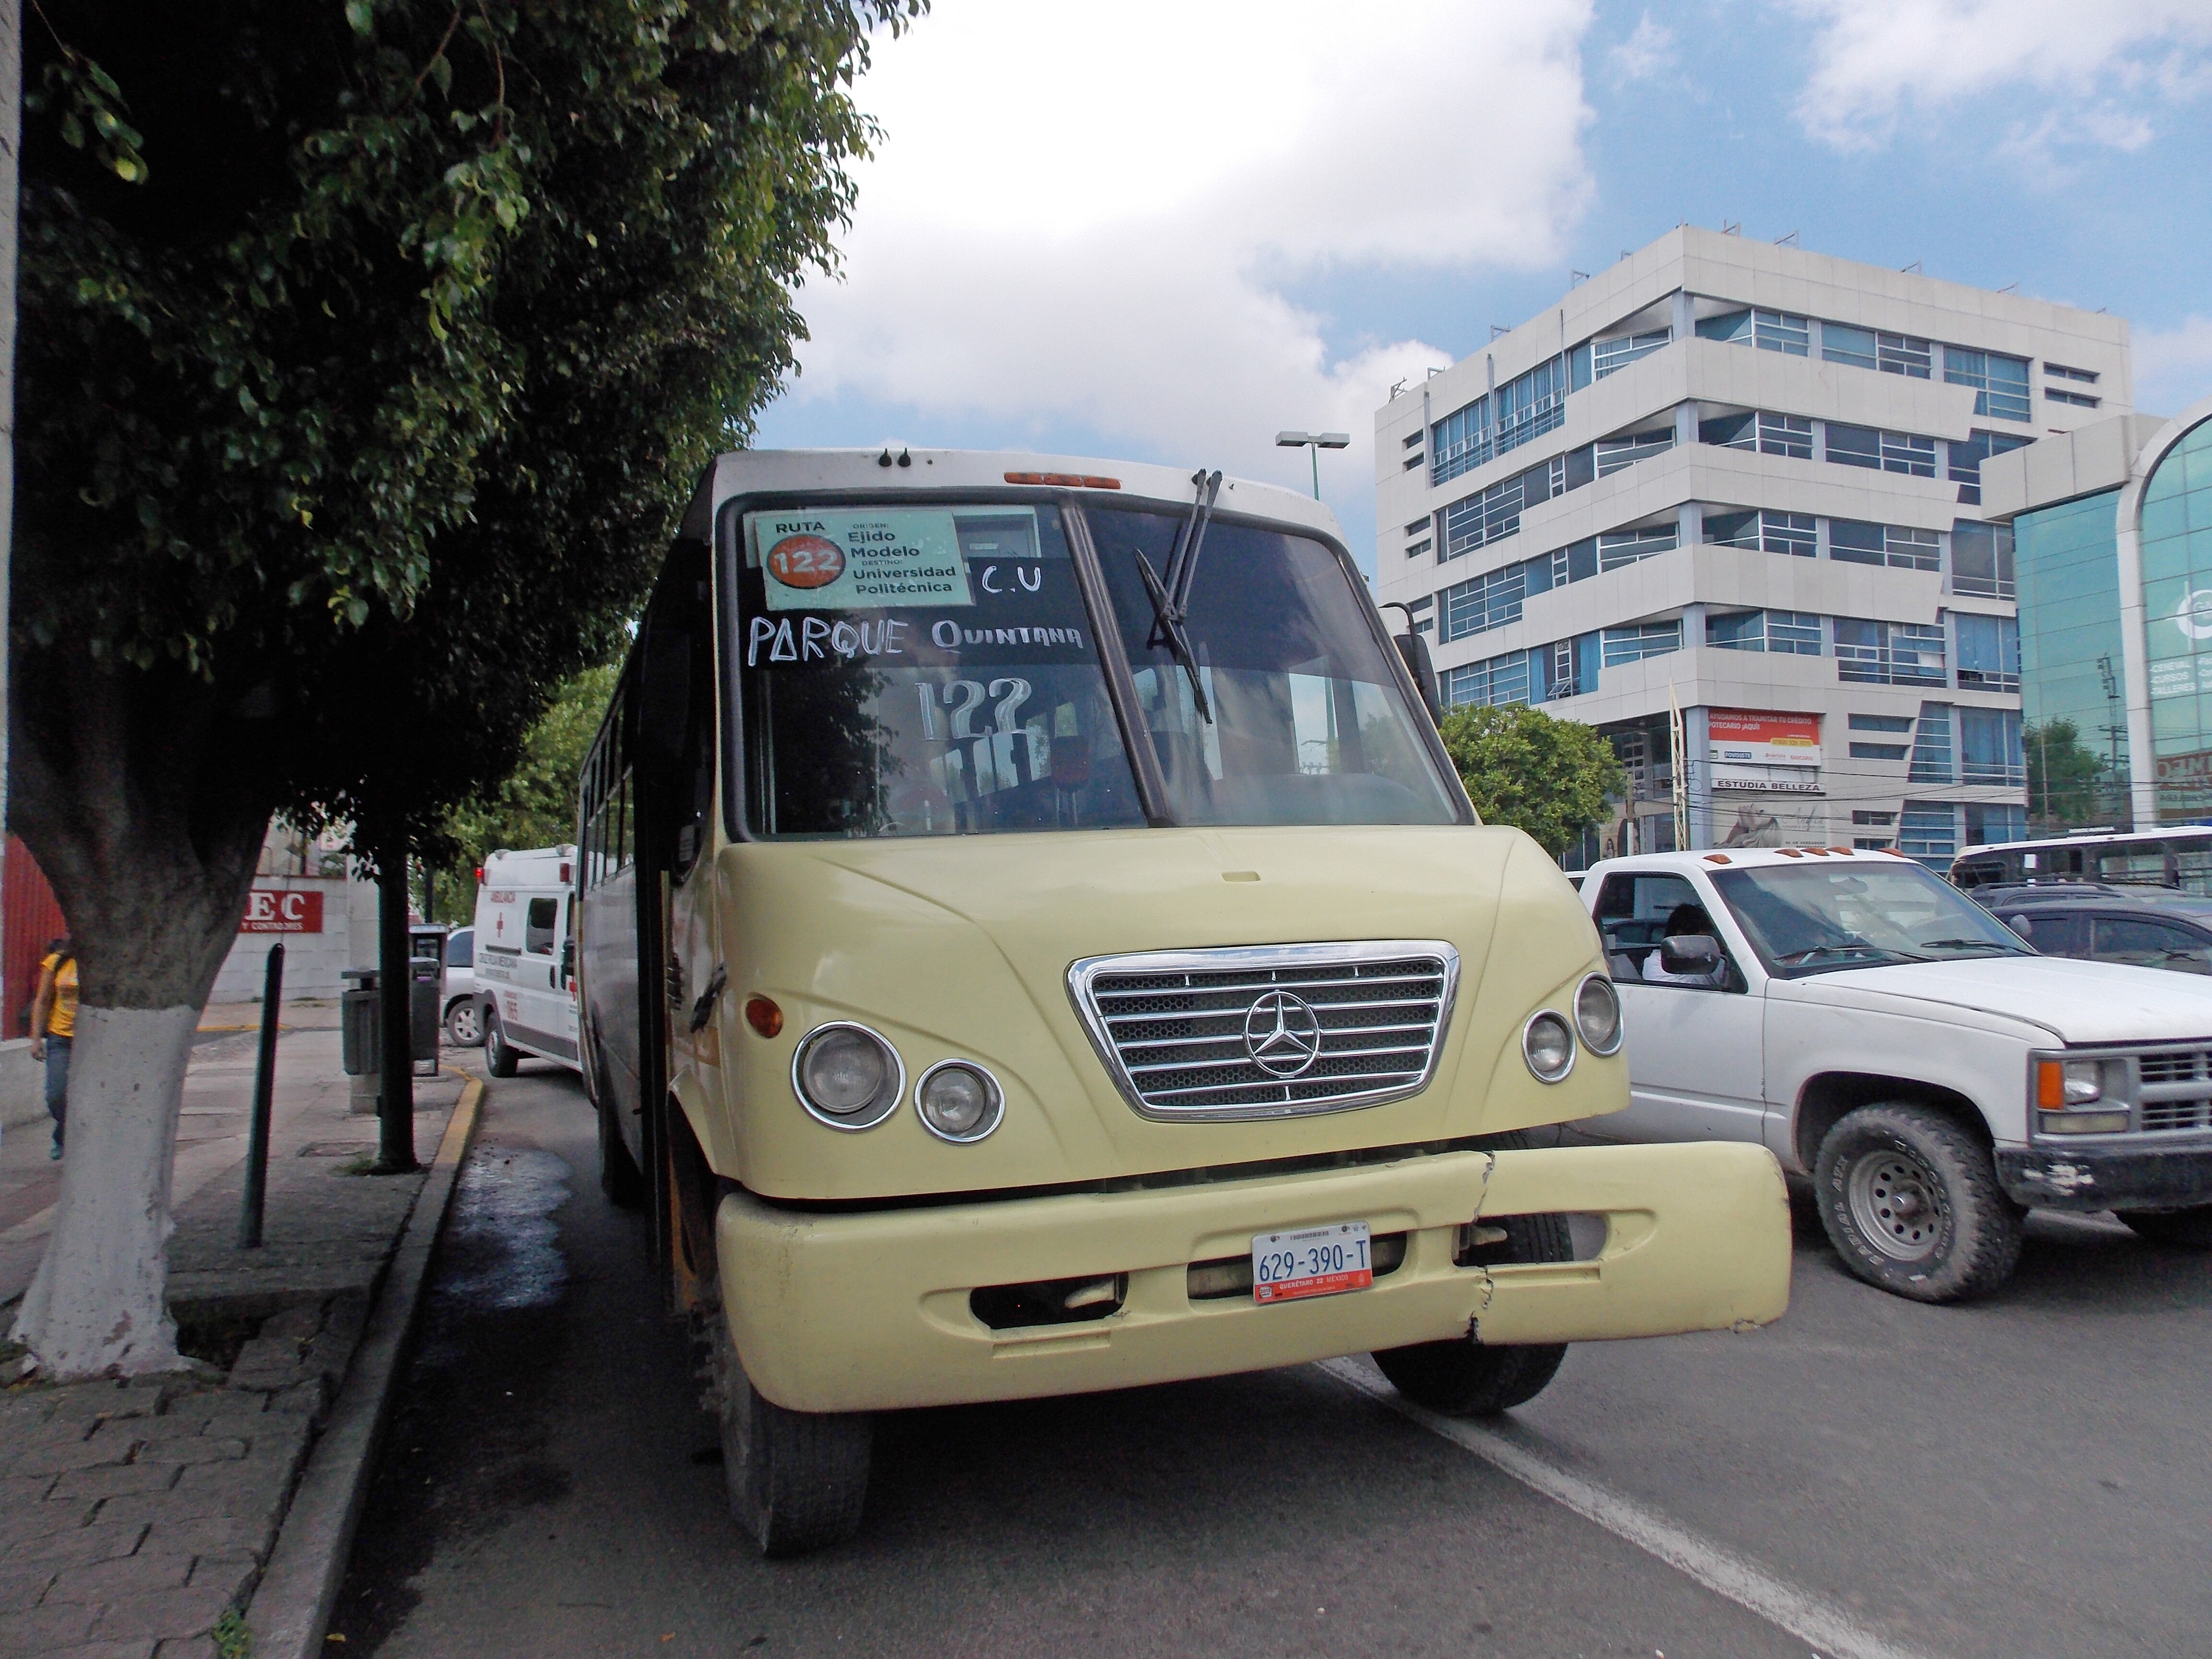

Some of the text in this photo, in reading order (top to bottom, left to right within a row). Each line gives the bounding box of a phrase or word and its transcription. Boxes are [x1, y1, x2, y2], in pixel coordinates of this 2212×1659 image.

[775, 521, 826, 533] RUTA
[848, 530, 896, 543] Ejido
[850, 546, 920, 558] Modelo
[773, 549, 840, 574] 122
[853, 566, 956, 579] Universidad
[856, 581, 952, 595] Politécnica
[748, 616, 909, 667] PARQUE
[914, 677, 1033, 741] 122
[1718, 780, 1820, 791] ESTUDIA BELLEZA
[1259, 1239, 1366, 1282] 629-390-T
[1279, 1279, 1313, 1290] QUERÉTARO
